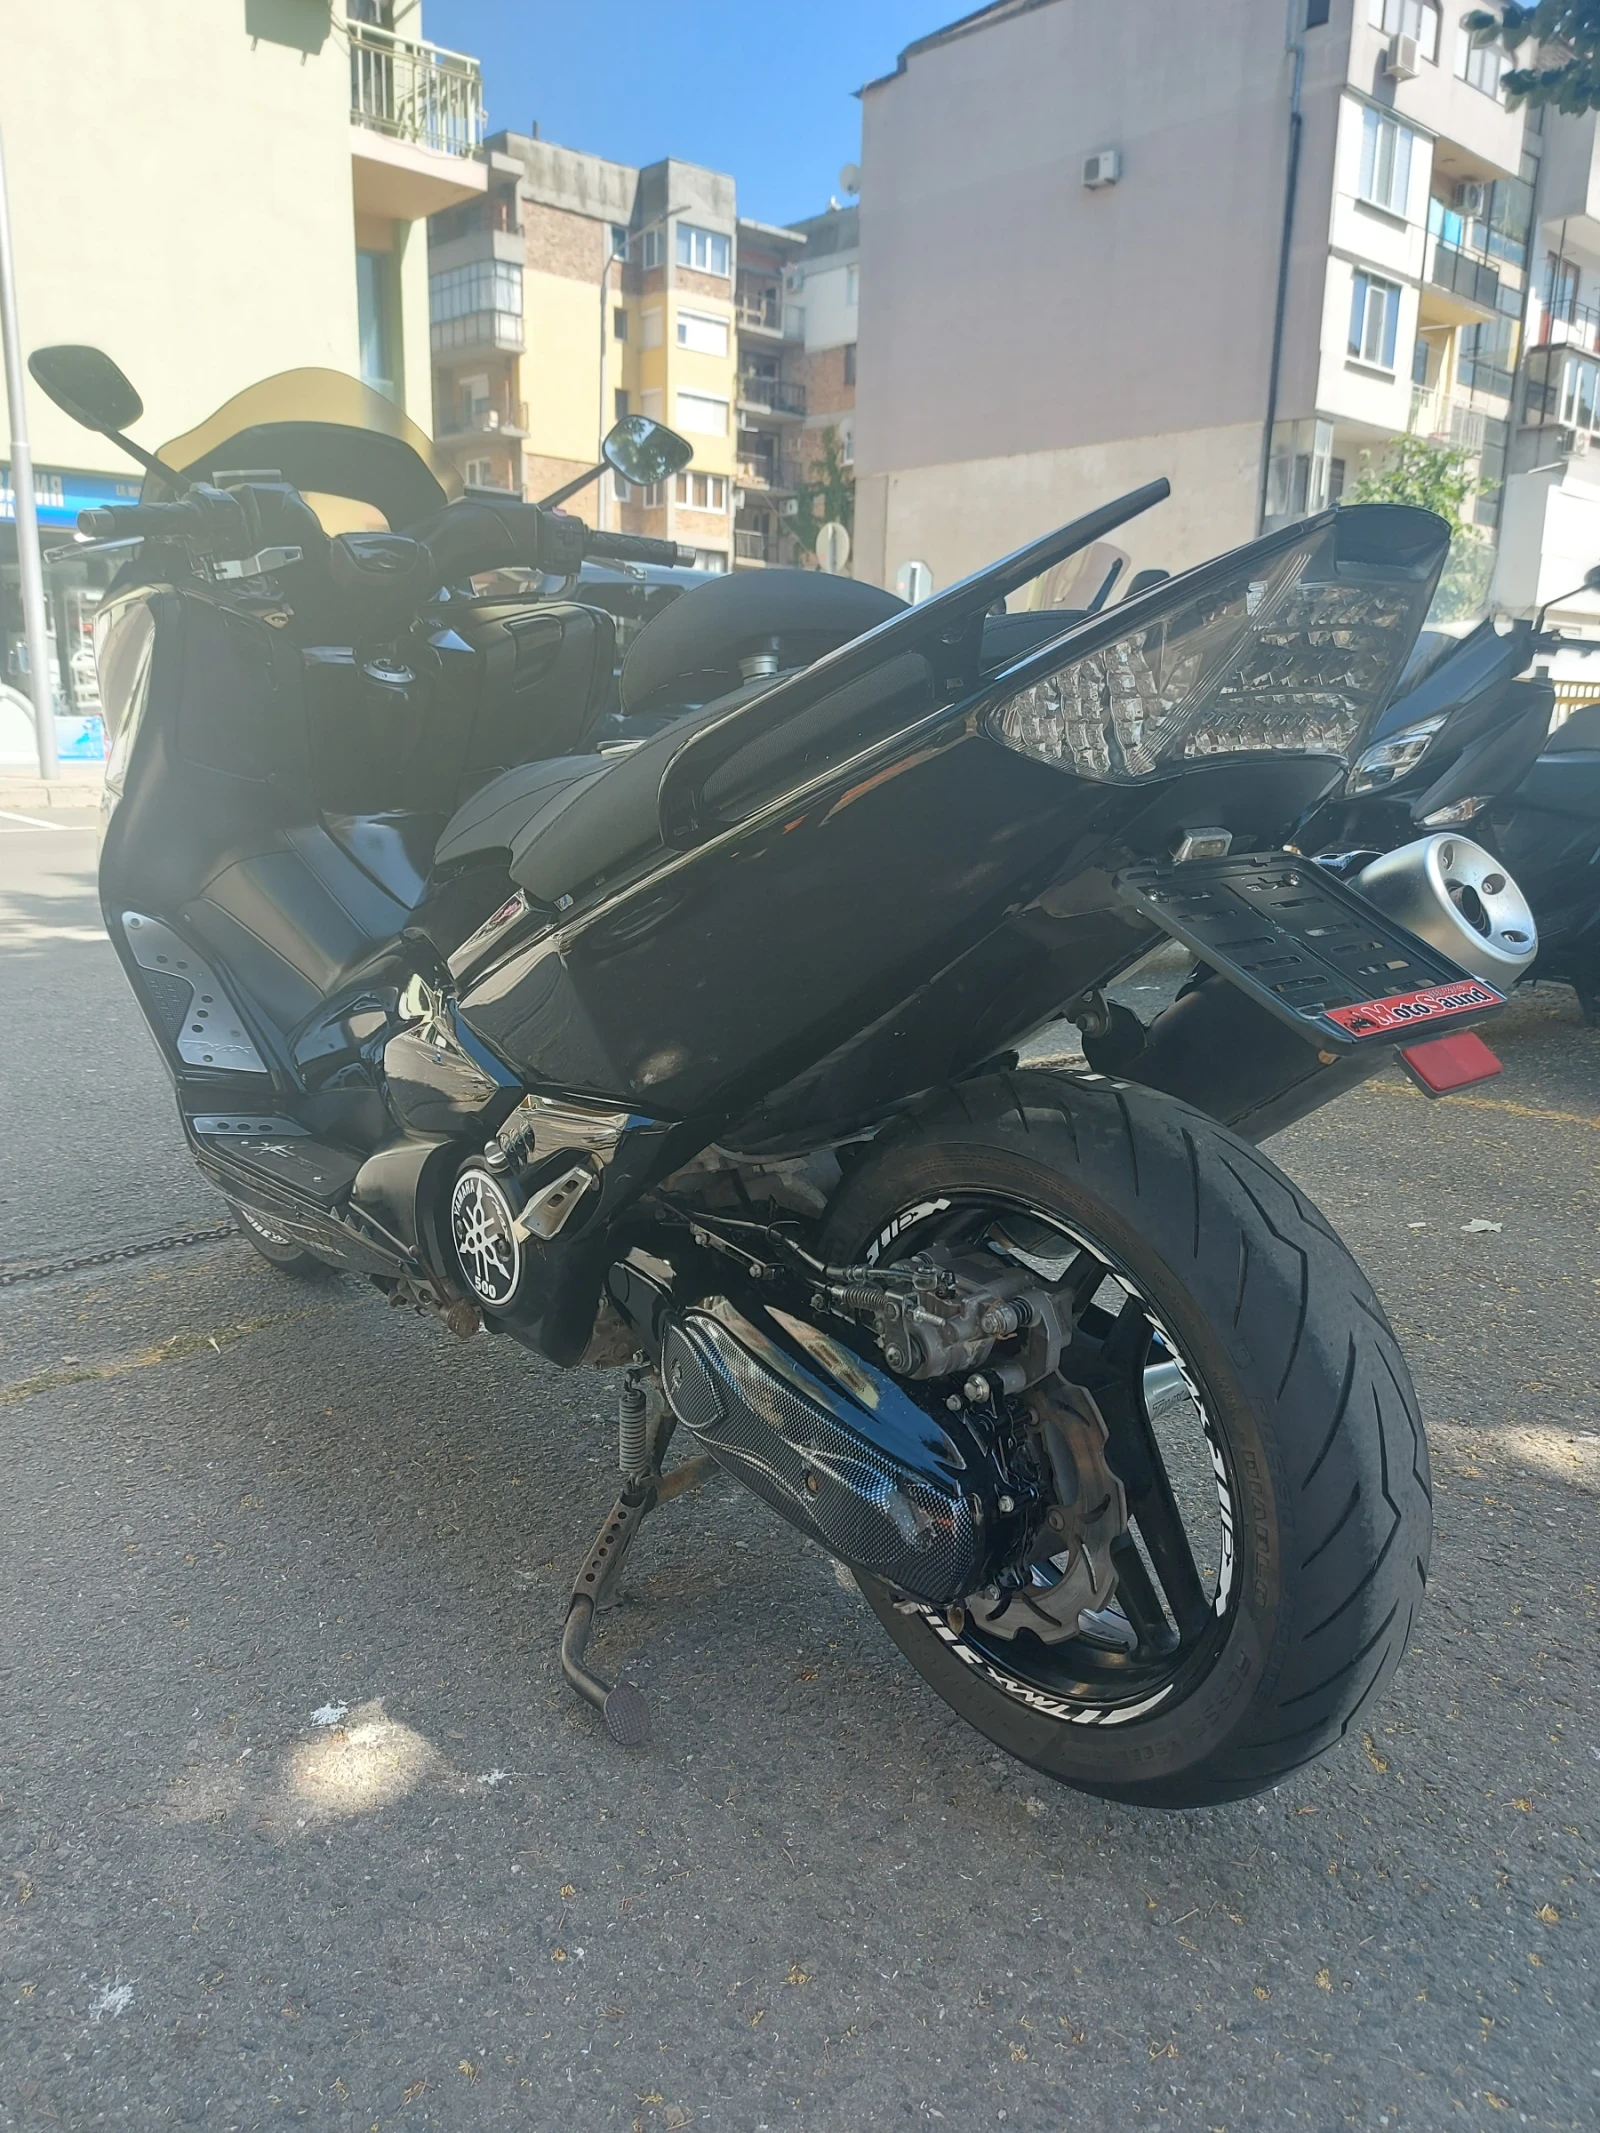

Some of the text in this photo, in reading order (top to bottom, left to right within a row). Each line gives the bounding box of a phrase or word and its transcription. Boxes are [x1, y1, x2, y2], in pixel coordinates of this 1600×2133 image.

[1361, 986, 1494, 1026] MotoSaund
[453, 1179, 476, 1217] YAMAHA
[474, 1275, 497, 1299] 500
[1242, 1450, 1270, 1609] DIABLO
